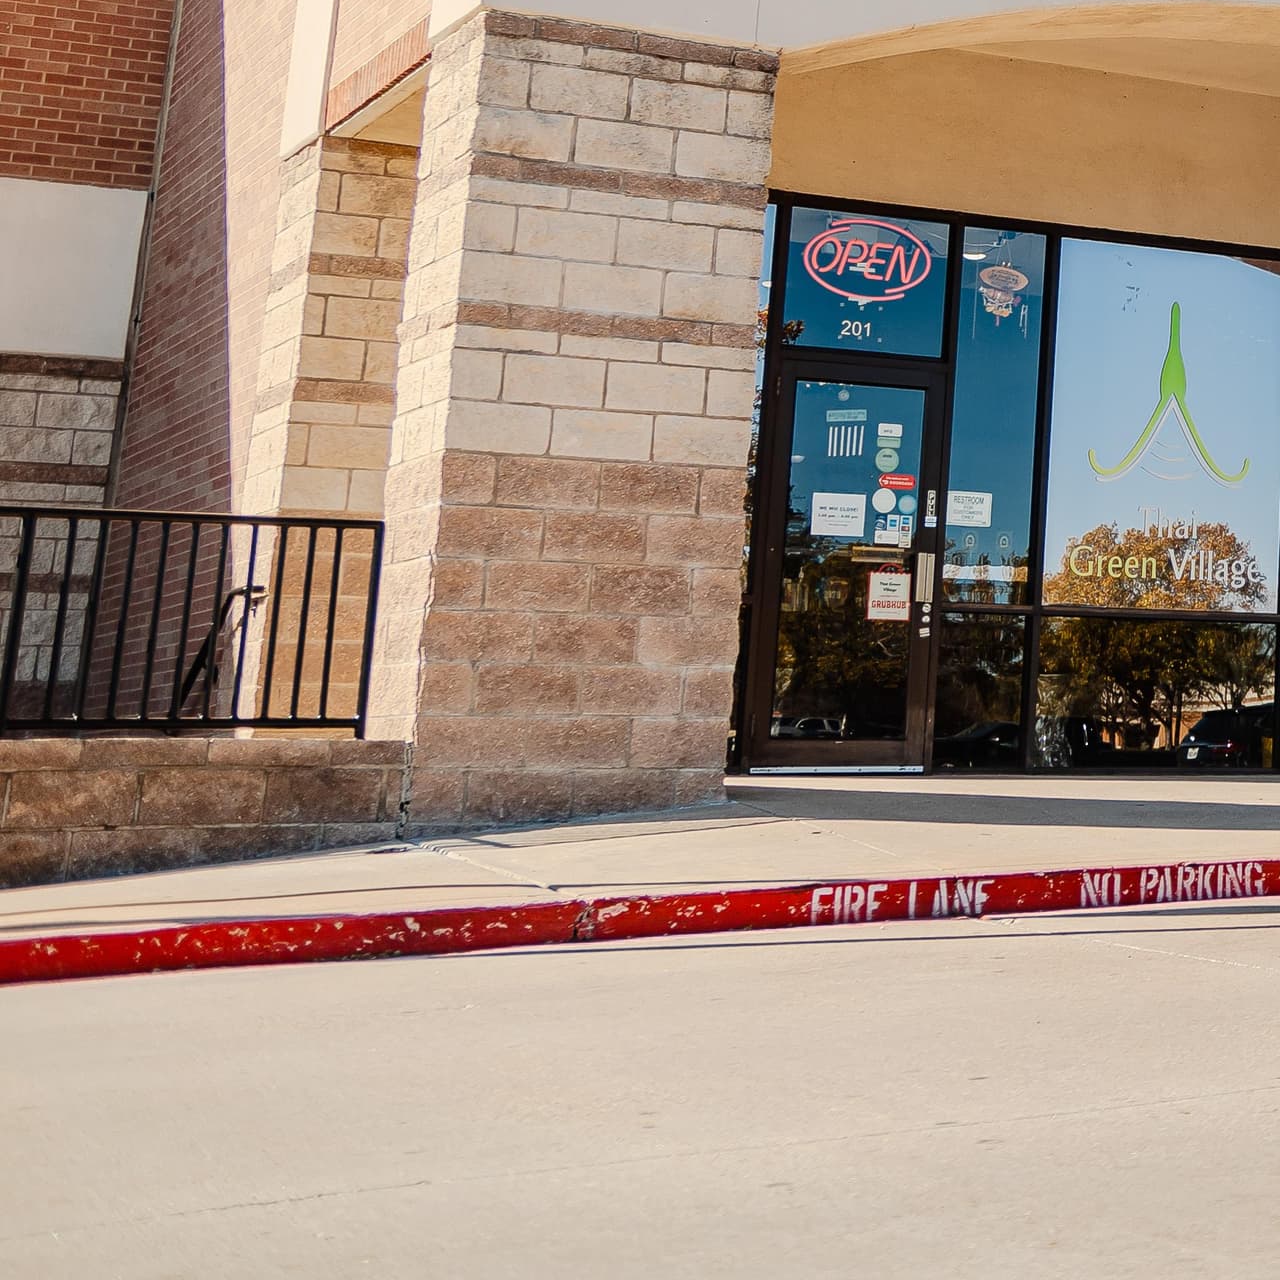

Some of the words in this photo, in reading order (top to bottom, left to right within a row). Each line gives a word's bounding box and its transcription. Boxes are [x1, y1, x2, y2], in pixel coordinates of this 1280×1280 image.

[811, 236, 921, 284] OPEN
[841, 320, 871, 337] 201
[953, 495, 985, 505] RESTROOM
[1137, 506, 1199, 540] Thai
[1068, 545, 1157, 579] Green
[1168, 548, 1266, 588] Village
[871, 600, 907, 609] GRUBHUB
[810, 883, 888, 925] FIRE
[908, 879, 995, 920] LANE
[1080, 869, 1121, 908] NO
[1140, 862, 1267, 905] PARKING
